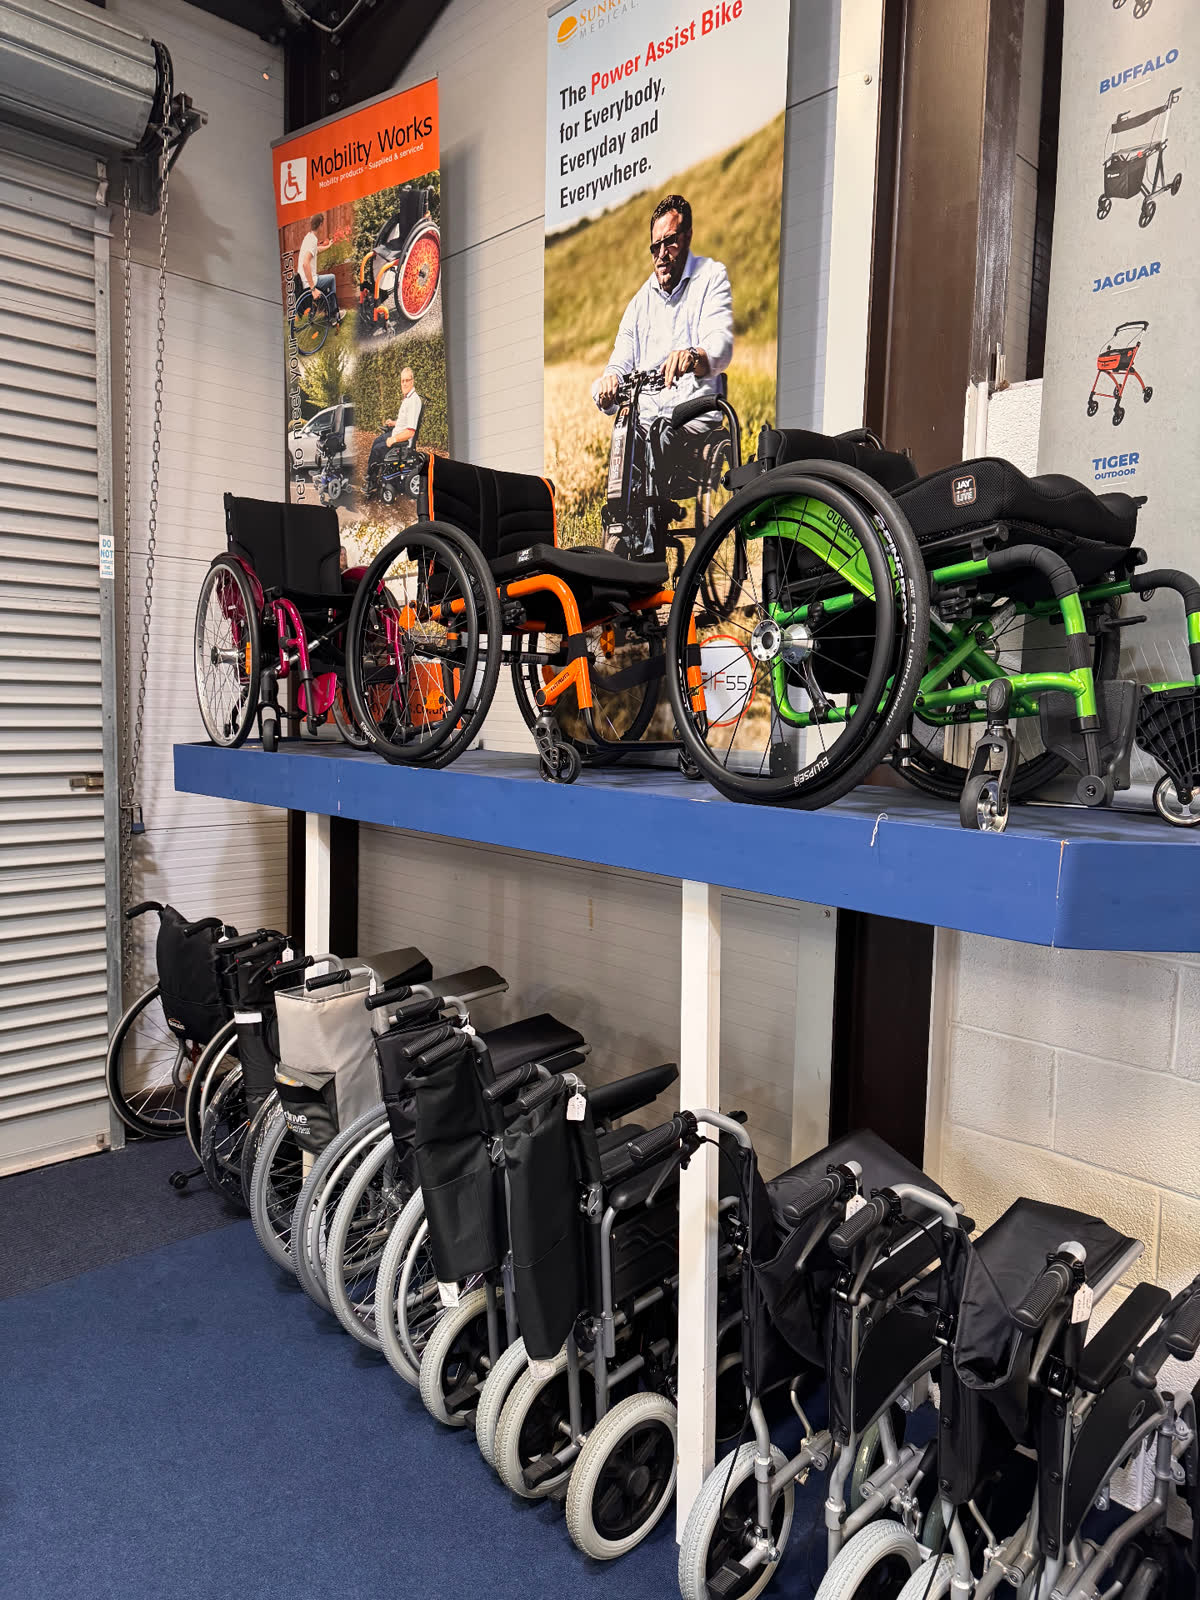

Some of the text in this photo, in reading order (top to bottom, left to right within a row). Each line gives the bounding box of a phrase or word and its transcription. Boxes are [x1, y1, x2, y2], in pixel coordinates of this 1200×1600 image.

[580, 0, 621, 28] SUNR
[559, 0, 743, 110] The Power Assist Bike
[1099, 49, 1179, 94] BUFFALO
[559, 77, 666, 144] for Everybody,
[311, 116, 432, 180] Mobility Works
[318, 174, 340, 189] Mobility
[339, 166, 364, 182] products
[368, 154, 393, 171] Supplied
[393, 152, 399, 161] &
[399, 142, 424, 159] serviced
[560, 110, 659, 177] Everyday and
[560, 156, 652, 209] Everywhere.
[1092, 261, 1161, 293] JAGUAR
[289, 335, 302, 383] your
[290, 387, 303, 440] meet
[614, 406, 630, 454] Emplse
[293, 448, 305, 470] to
[1092, 451, 1140, 471] TIGER
[1094, 467, 1136, 480] OUTDOOR
[956, 478, 973, 490] JAY
[100, 549, 114, 559] NOT
[102, 539, 112, 548] DO
[885, 648, 914, 727] MARATHON
[799, 756, 830, 784] ELLIPSE
